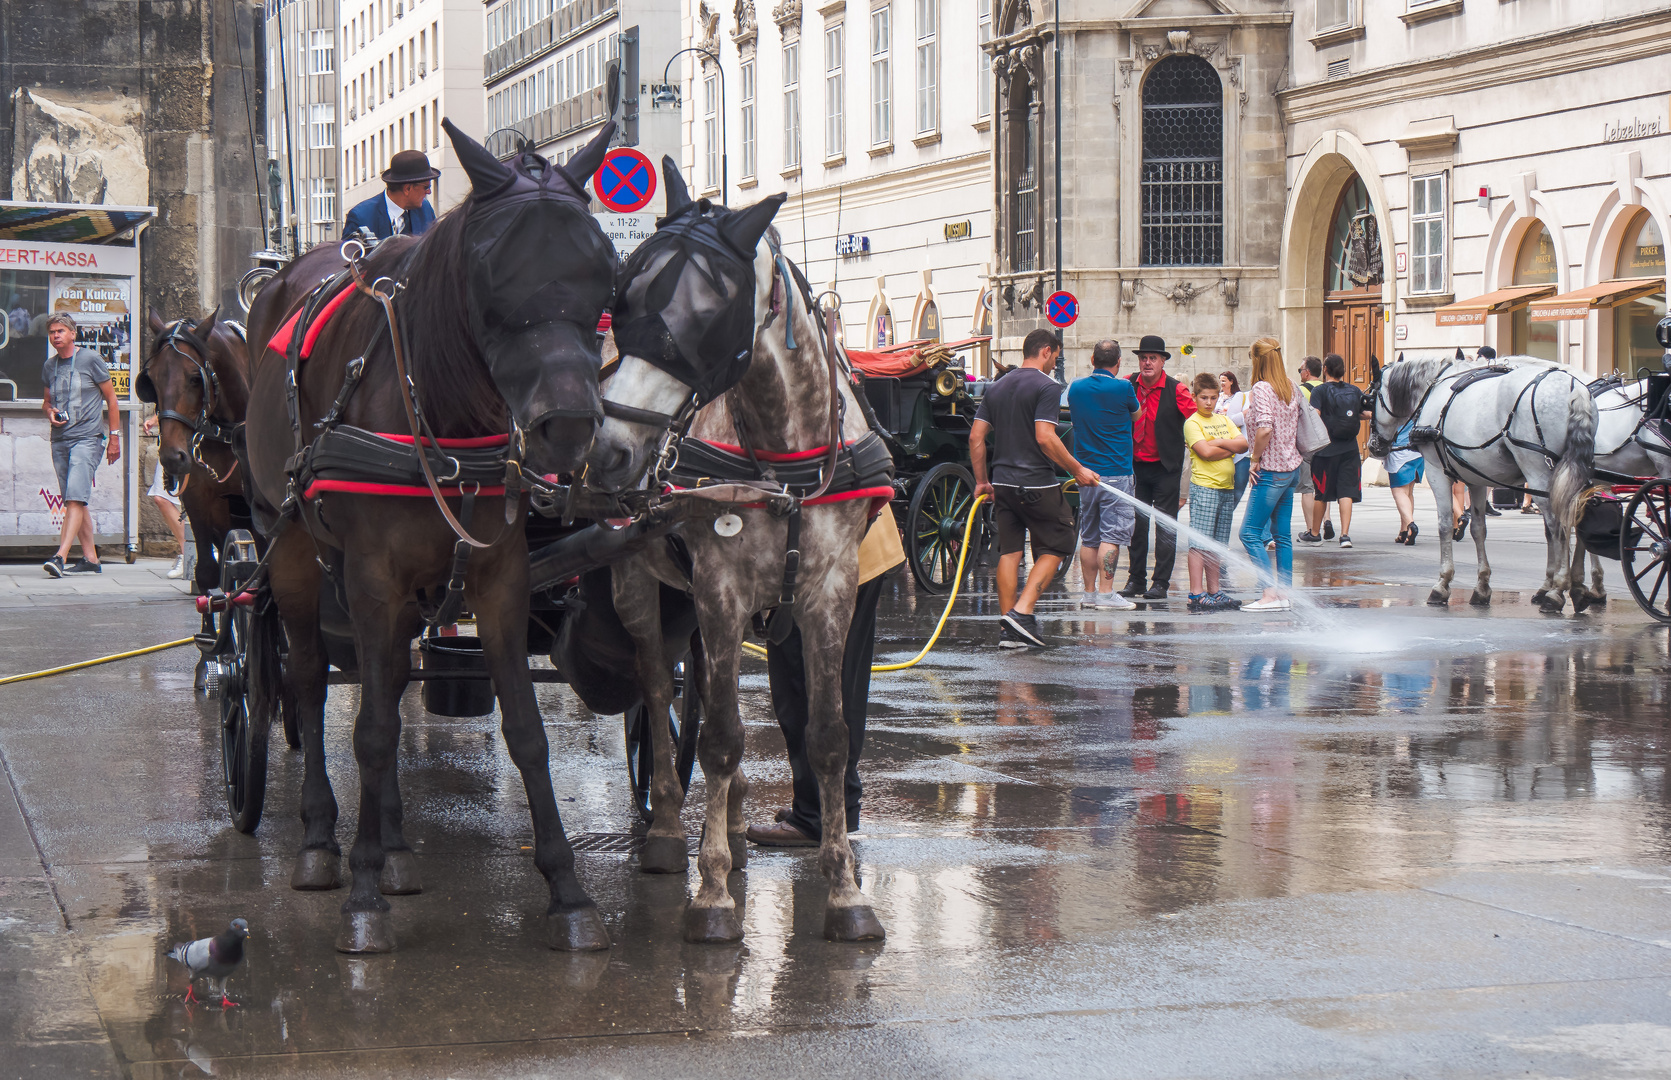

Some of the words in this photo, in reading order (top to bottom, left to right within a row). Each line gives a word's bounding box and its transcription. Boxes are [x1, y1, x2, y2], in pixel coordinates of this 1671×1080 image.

[1603, 115, 1661, 143] Lebzelterei
[1640, 246, 1659, 256] PIRKER
[1535, 255, 1551, 264] PIRKER
[57, 288, 83, 300] Yoan
[86, 289, 130, 301] Kukuzel
[80, 300, 107, 312] Chor
